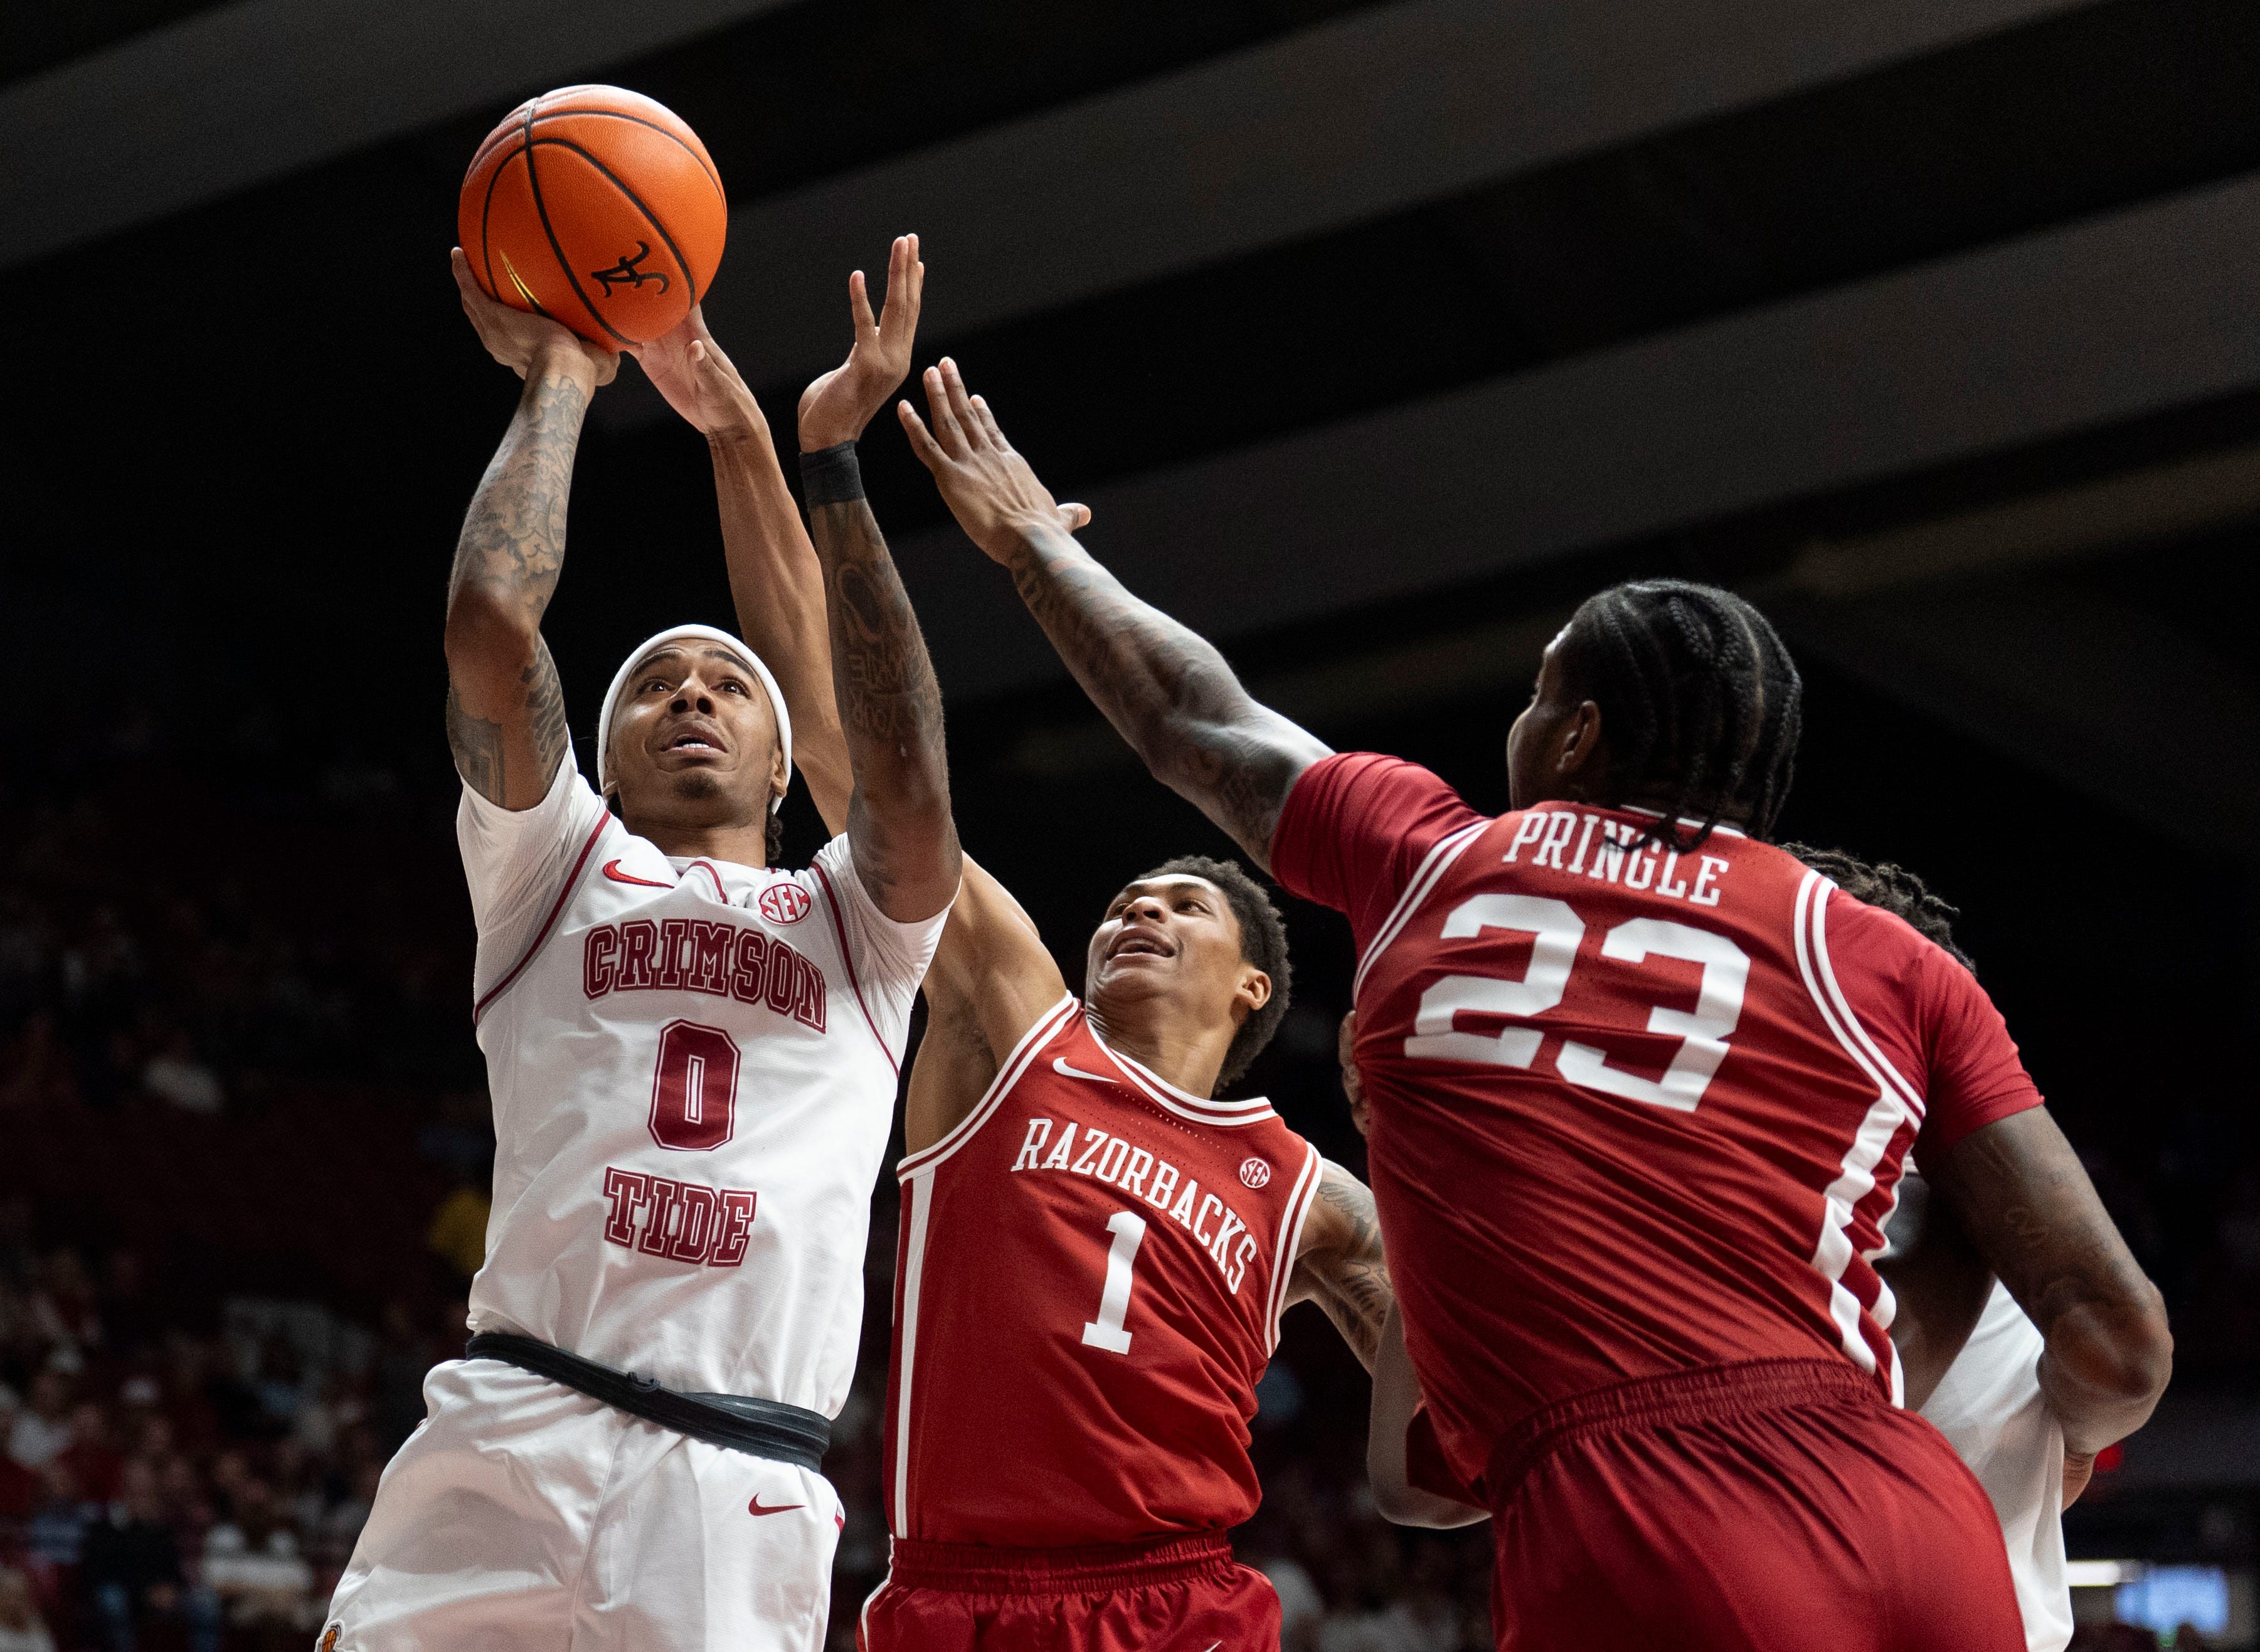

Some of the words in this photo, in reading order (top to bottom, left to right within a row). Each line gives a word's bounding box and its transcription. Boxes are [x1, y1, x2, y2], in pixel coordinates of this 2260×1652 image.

[760, 885, 808, 921] SEC
[1502, 812, 1729, 906] PRINGLE
[584, 918, 826, 1034] CRIMSON
[1404, 894, 1751, 1112] 23
[647, 1019, 741, 1151] 0
[603, 1167, 756, 1267] TIDE
[1011, 1118, 1258, 1295] RAZORBACKS
[1241, 1160, 1268, 1187] SEC
[1081, 1210, 1147, 1355] 1
